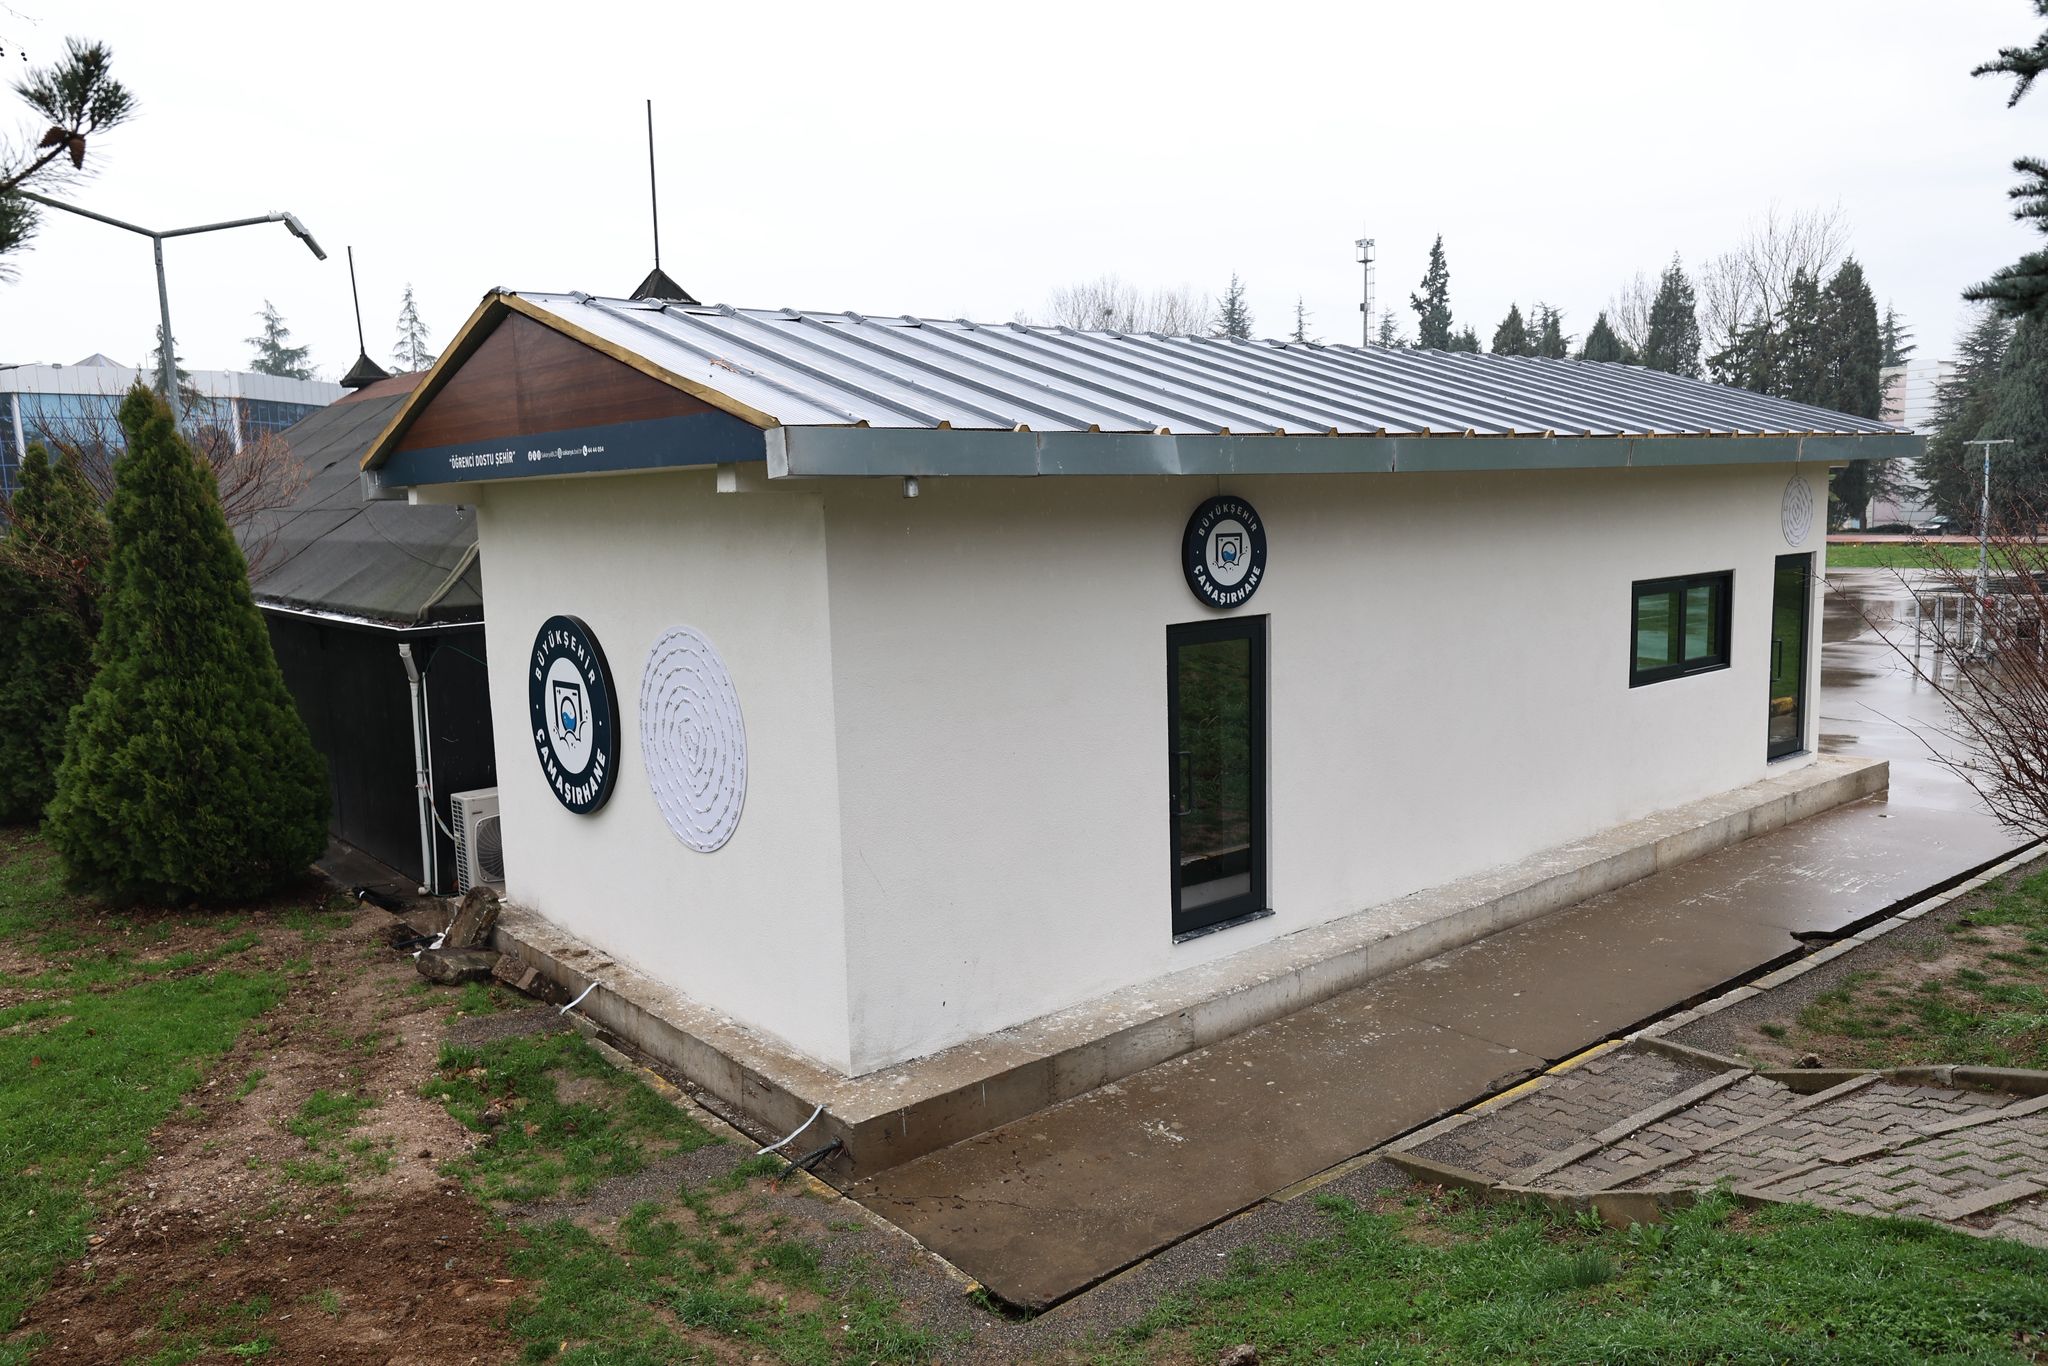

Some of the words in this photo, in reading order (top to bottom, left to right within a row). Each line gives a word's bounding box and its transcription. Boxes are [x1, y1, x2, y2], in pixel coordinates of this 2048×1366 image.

[475, 453, 494, 467] DOSTU
[1198, 503, 1257, 537] BÜYÜKŞEHİR
[1194, 564, 1261, 605] ÇAMAŞIRHANE
[535, 629, 596, 686] BÜYÜKŞEHİR
[535, 728, 606, 806] ÇAMAŞIRHANE
